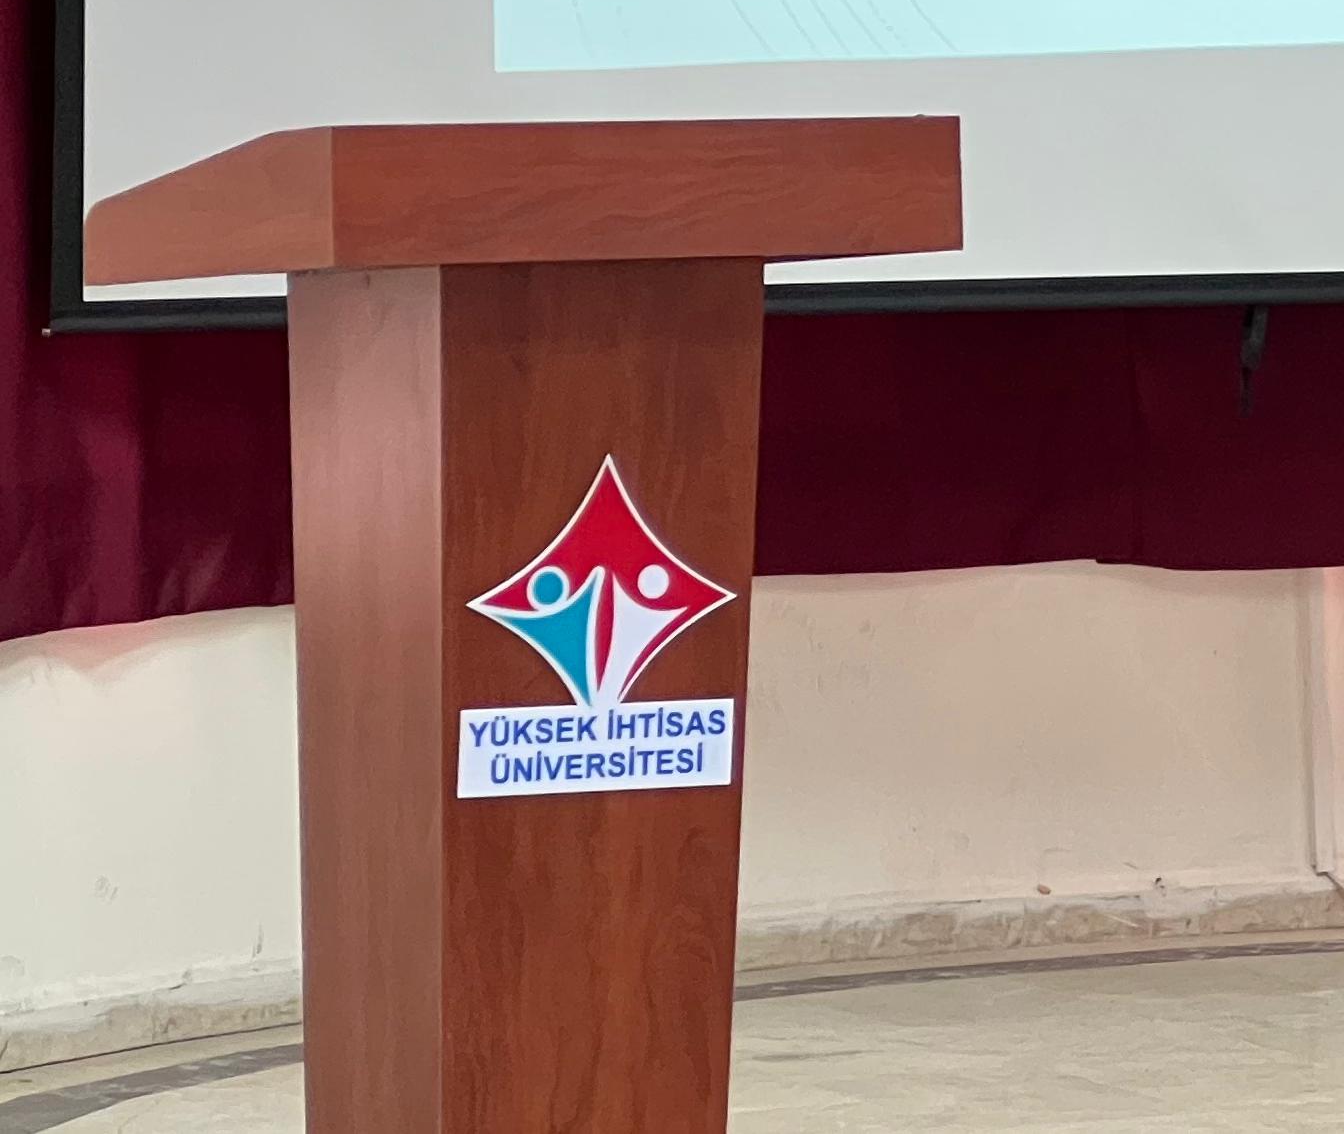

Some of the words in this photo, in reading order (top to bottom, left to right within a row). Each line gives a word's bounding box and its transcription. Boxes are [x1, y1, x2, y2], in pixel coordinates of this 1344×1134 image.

[469, 715, 599, 748] YÜKSEK
[606, 707, 726, 740] İHTİSAS
[490, 742, 704, 784] ÜNİVERSİTESİ
